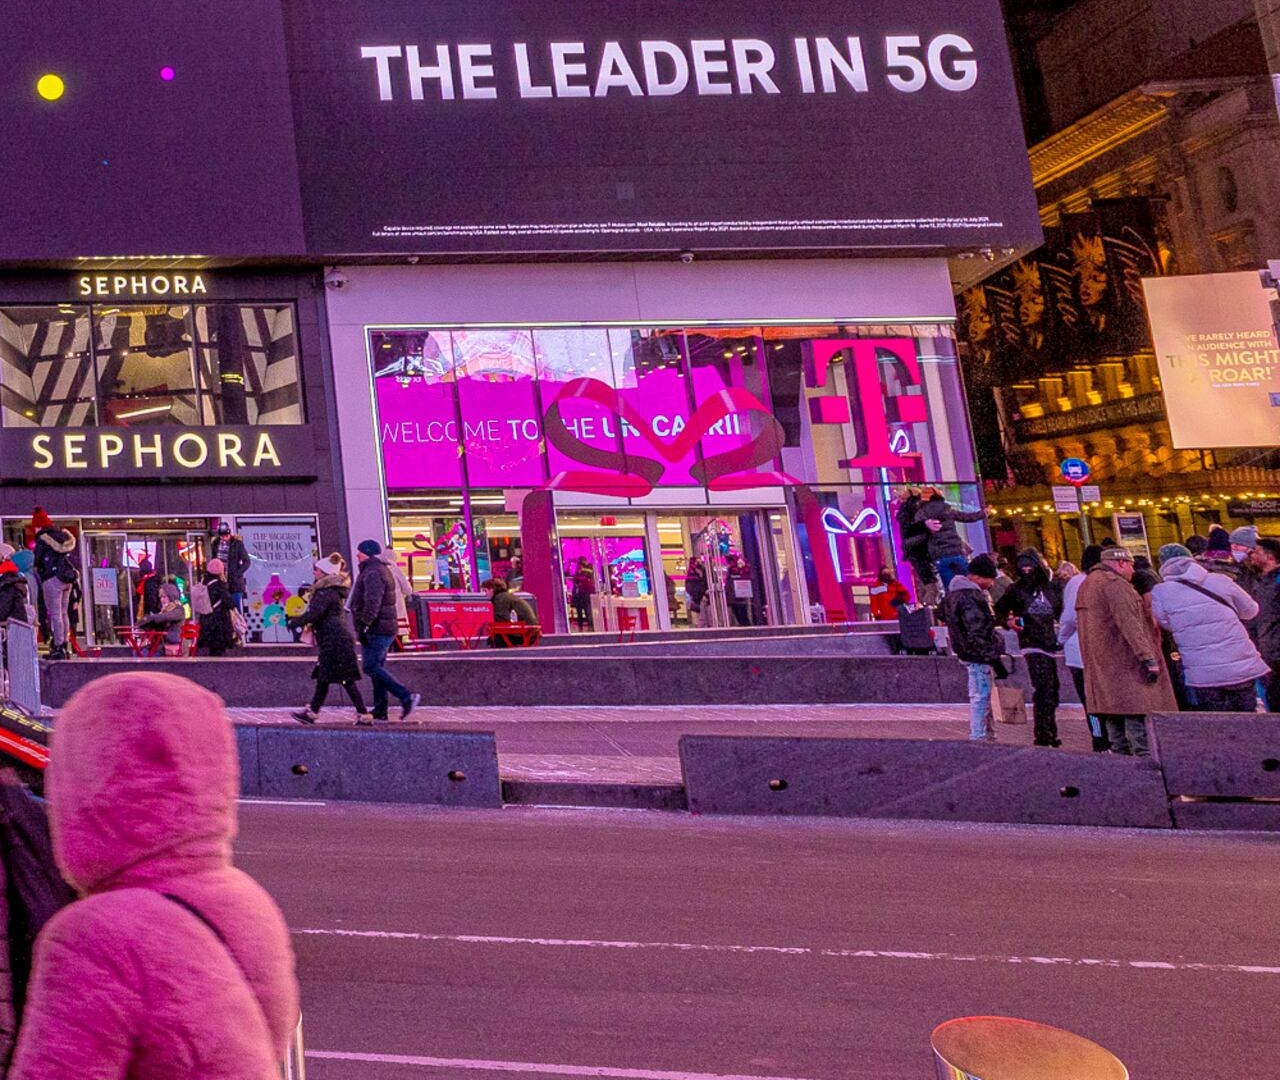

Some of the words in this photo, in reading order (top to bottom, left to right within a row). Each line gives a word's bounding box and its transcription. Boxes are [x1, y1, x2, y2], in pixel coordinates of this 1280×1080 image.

[360, 45, 497, 100] THE
[514, 39, 781, 98] LEADER
[795, 37, 868, 93] IN
[886, 34, 978, 92] 5G
[80, 275, 207, 295] SEPHORA
[1199, 332, 1234, 342] RARELY
[1236, 330, 1271, 340] HEARD
[1197, 341, 1245, 351] AUDIENCE
[1247, 340, 1273, 348] WITH
[1215, 350, 1280, 366] MIGHT
[1209, 367, 1273, 383] ROAR!
[382, 419, 500, 443] WELCOME
[507, 419, 538, 441] TO
[562, 417, 595, 439] HE
[32, 433, 281, 469] SEPHORA
[252, 541, 303, 551] SEPHORA
